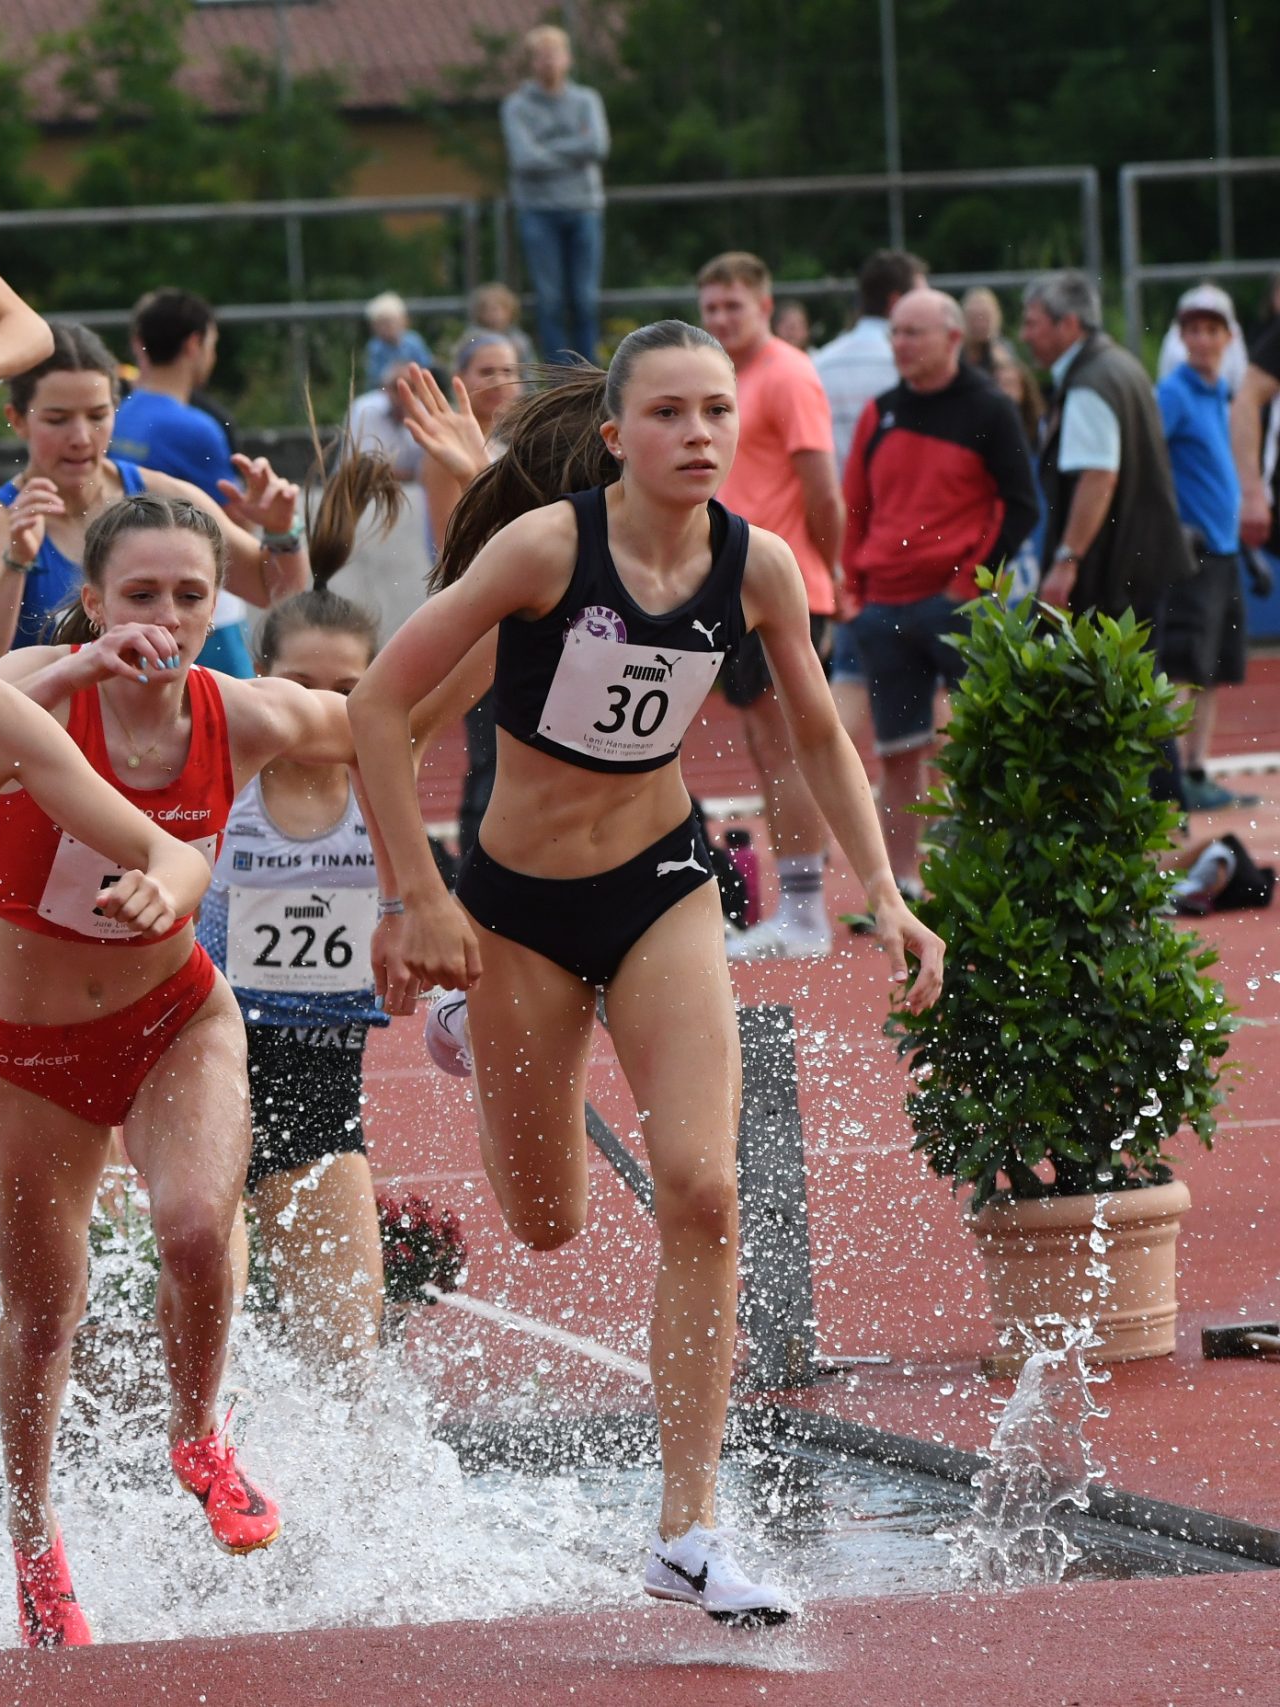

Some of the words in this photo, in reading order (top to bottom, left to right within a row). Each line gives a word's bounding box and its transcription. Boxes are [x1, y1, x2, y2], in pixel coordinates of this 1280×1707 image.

[584, 605, 621, 624] MTV
[623, 664, 666, 683] PUMA
[593, 684, 669, 738] 30
[256, 854, 302, 868] TELIS
[284, 905, 324, 919] PUMA
[253, 924, 353, 969] 226
